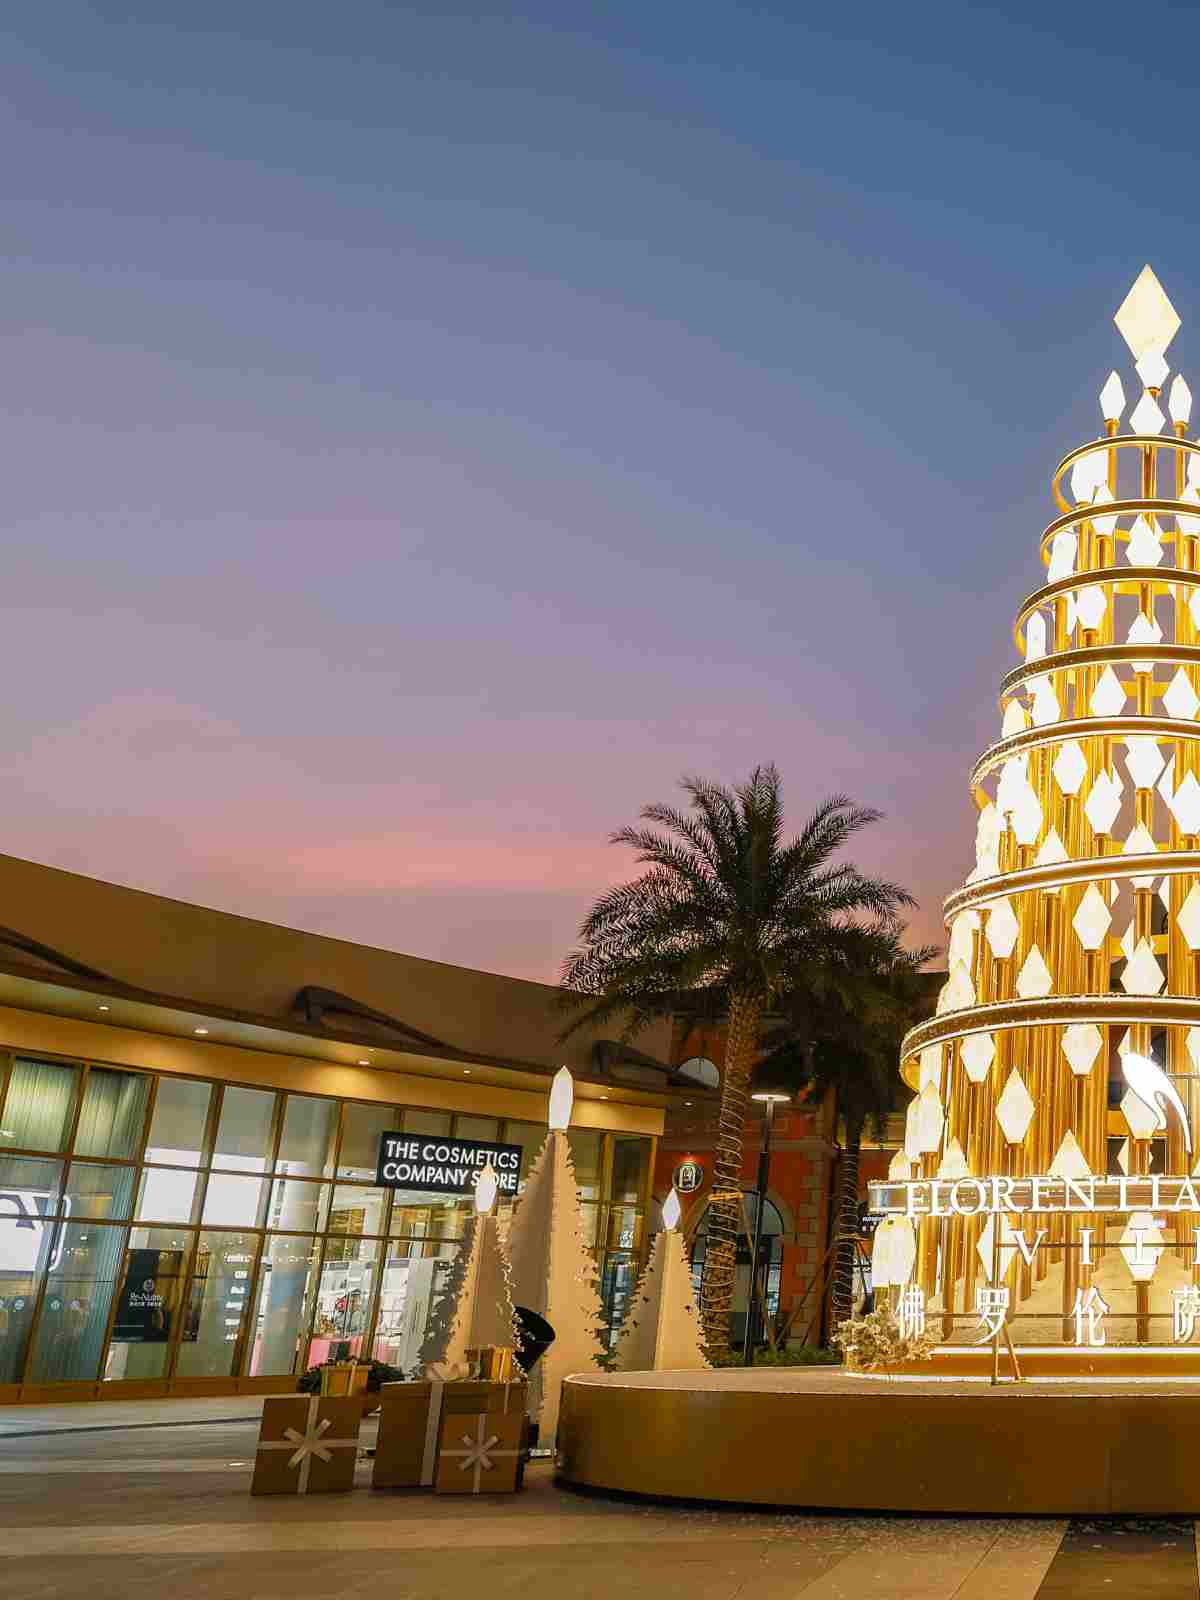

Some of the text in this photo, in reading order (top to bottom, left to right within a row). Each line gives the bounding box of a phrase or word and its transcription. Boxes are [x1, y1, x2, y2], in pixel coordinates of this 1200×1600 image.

[385, 1140, 519, 1169] THE COSMETICS
[382, 1163, 518, 1190] COMPANY SORE
